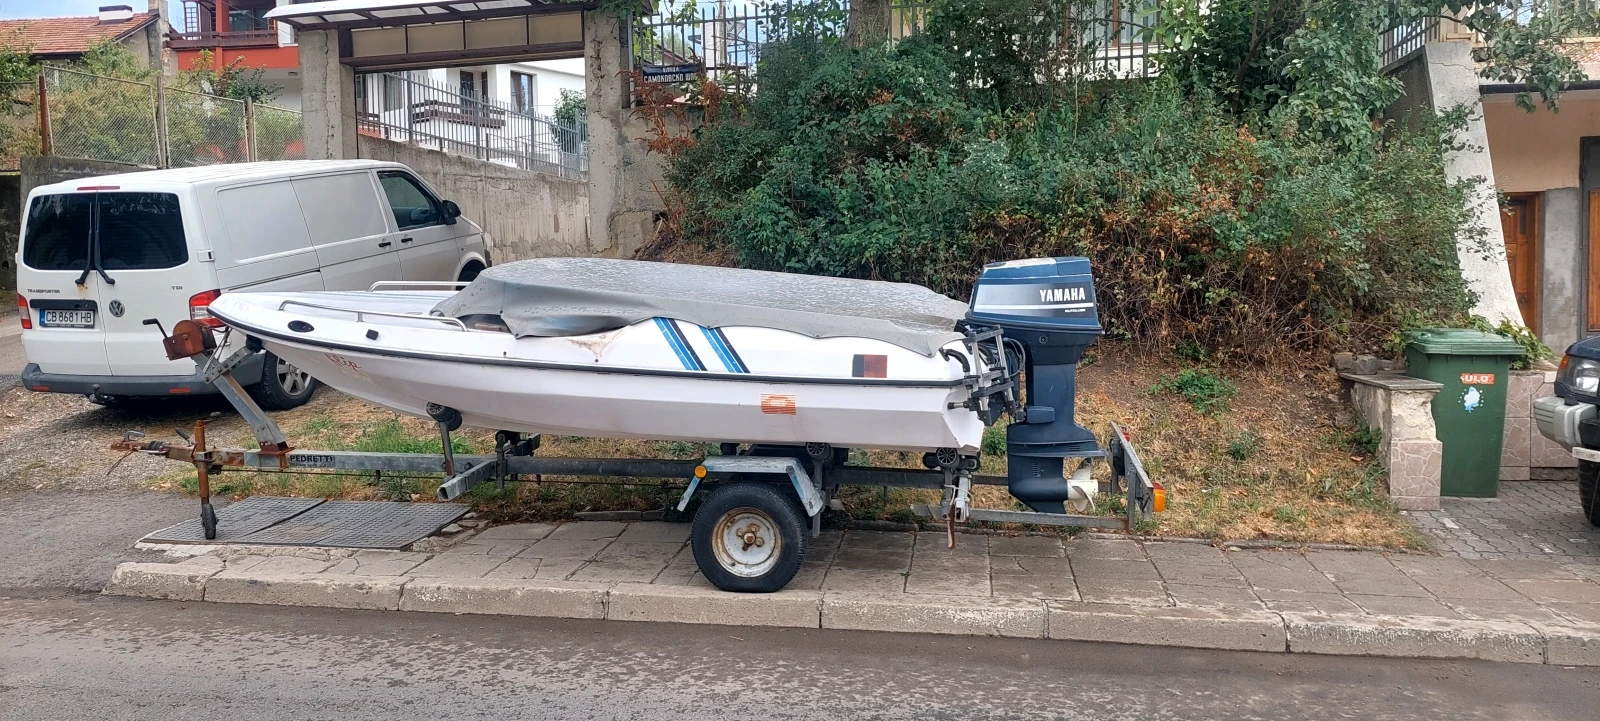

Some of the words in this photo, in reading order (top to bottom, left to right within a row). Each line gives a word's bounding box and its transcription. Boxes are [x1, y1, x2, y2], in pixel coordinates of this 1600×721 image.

[643, 73, 684, 84] САМОКОВСКО
[1039, 287, 1086, 302] YAMAHA
[46, 311, 57, 322] CB
[58, 311, 79, 322] 8681
[80, 312, 92, 323] HB
[290, 454, 333, 463] PEDRETTI
